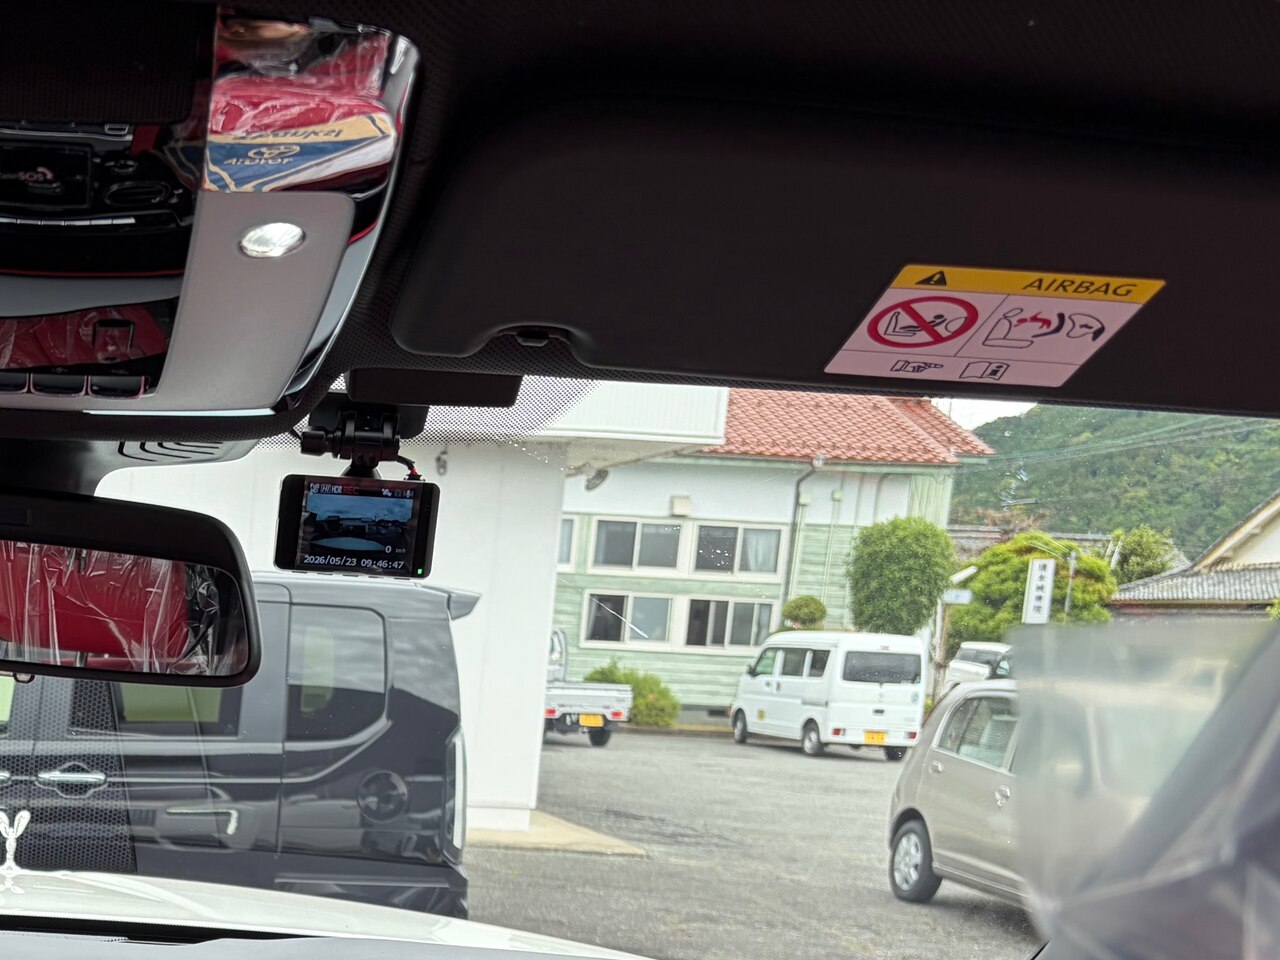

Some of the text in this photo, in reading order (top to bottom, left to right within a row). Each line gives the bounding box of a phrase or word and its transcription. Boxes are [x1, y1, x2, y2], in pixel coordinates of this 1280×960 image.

[1022, 278, 1138, 298] AIRBAG
[385, 545, 392, 554] 0
[303, 555, 404, 569] 2026/05/23 09:46:47
